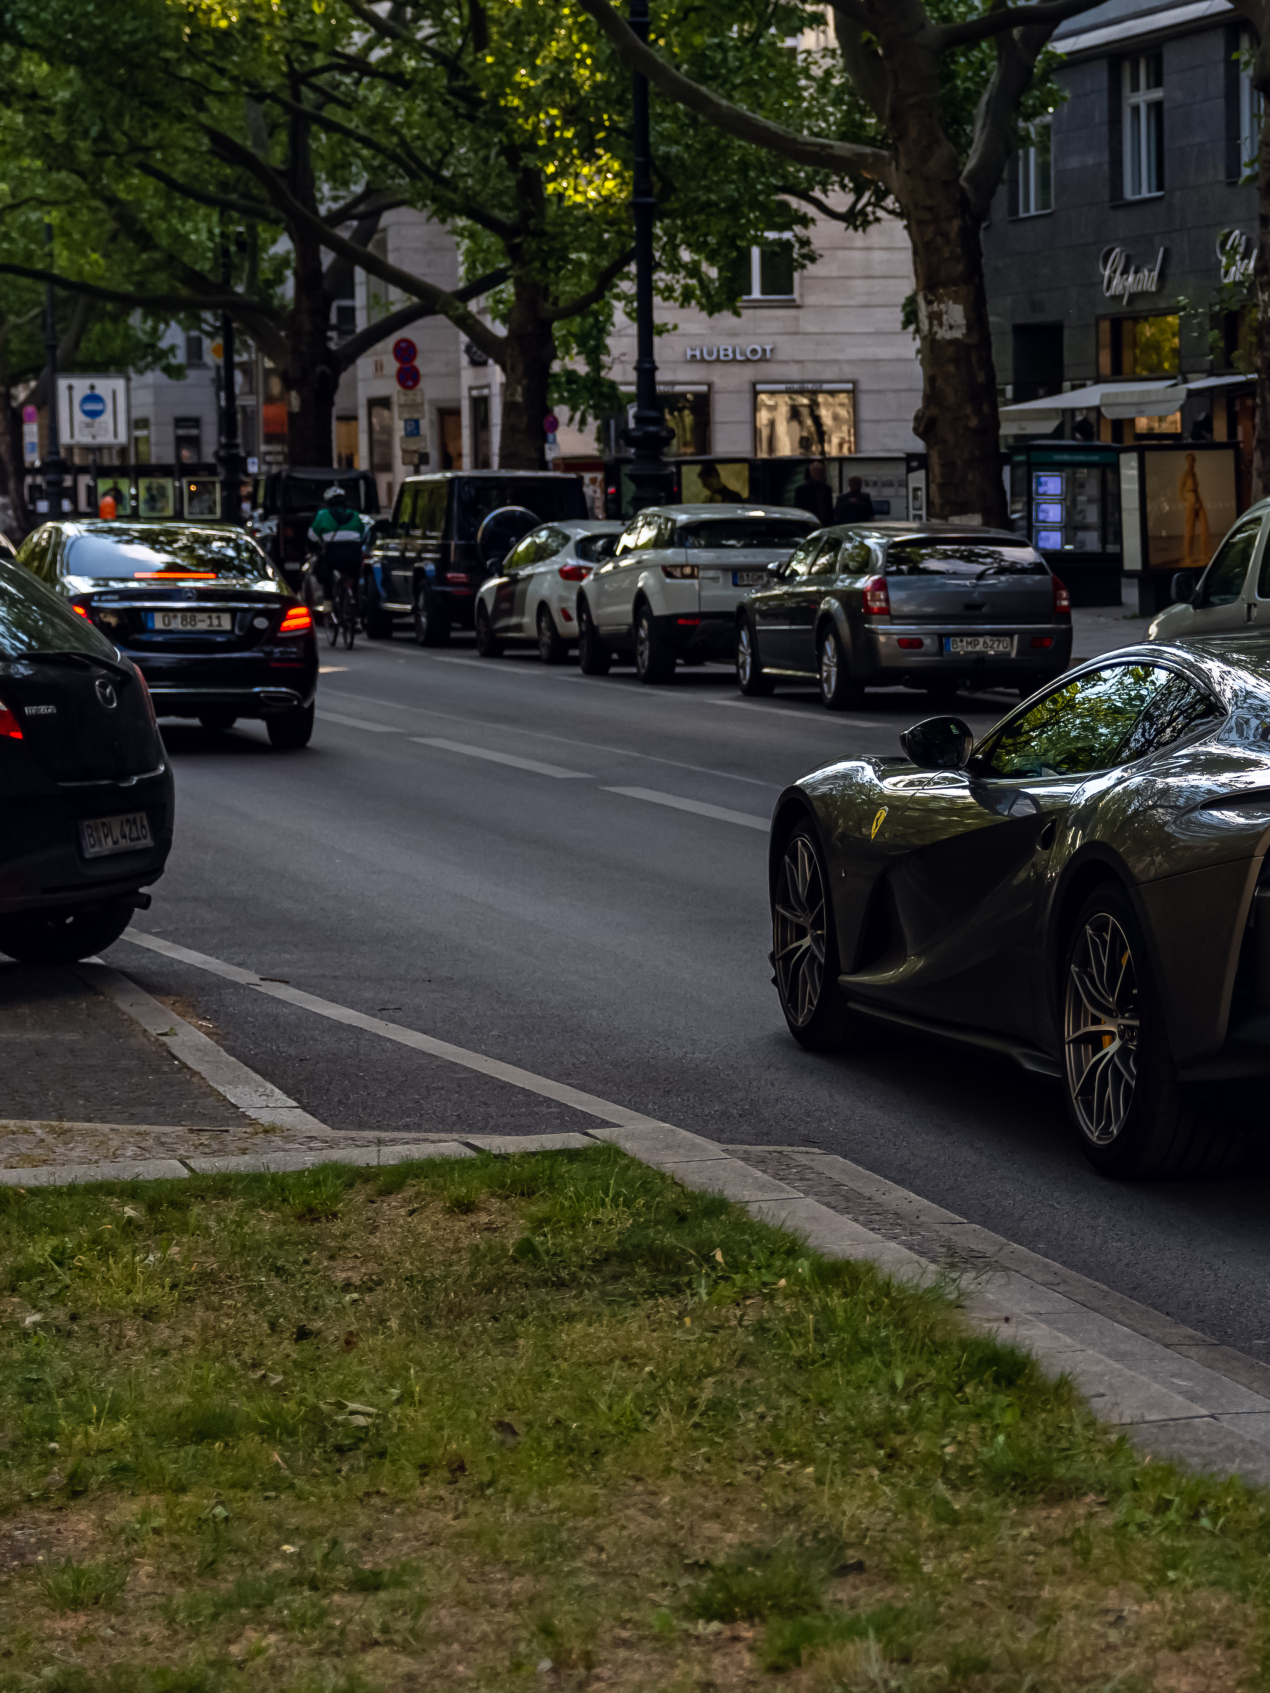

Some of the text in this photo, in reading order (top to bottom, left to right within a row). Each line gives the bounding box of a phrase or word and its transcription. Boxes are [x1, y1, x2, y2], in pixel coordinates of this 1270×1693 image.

[1099, 245, 1164, 306] Chopard
[686, 344, 774, 361] HUBLOT
[180, 613, 223, 628] 88-11
[951, 639, 1009, 649] B MP 6270
[86, 816, 148, 848] B PL 4216
